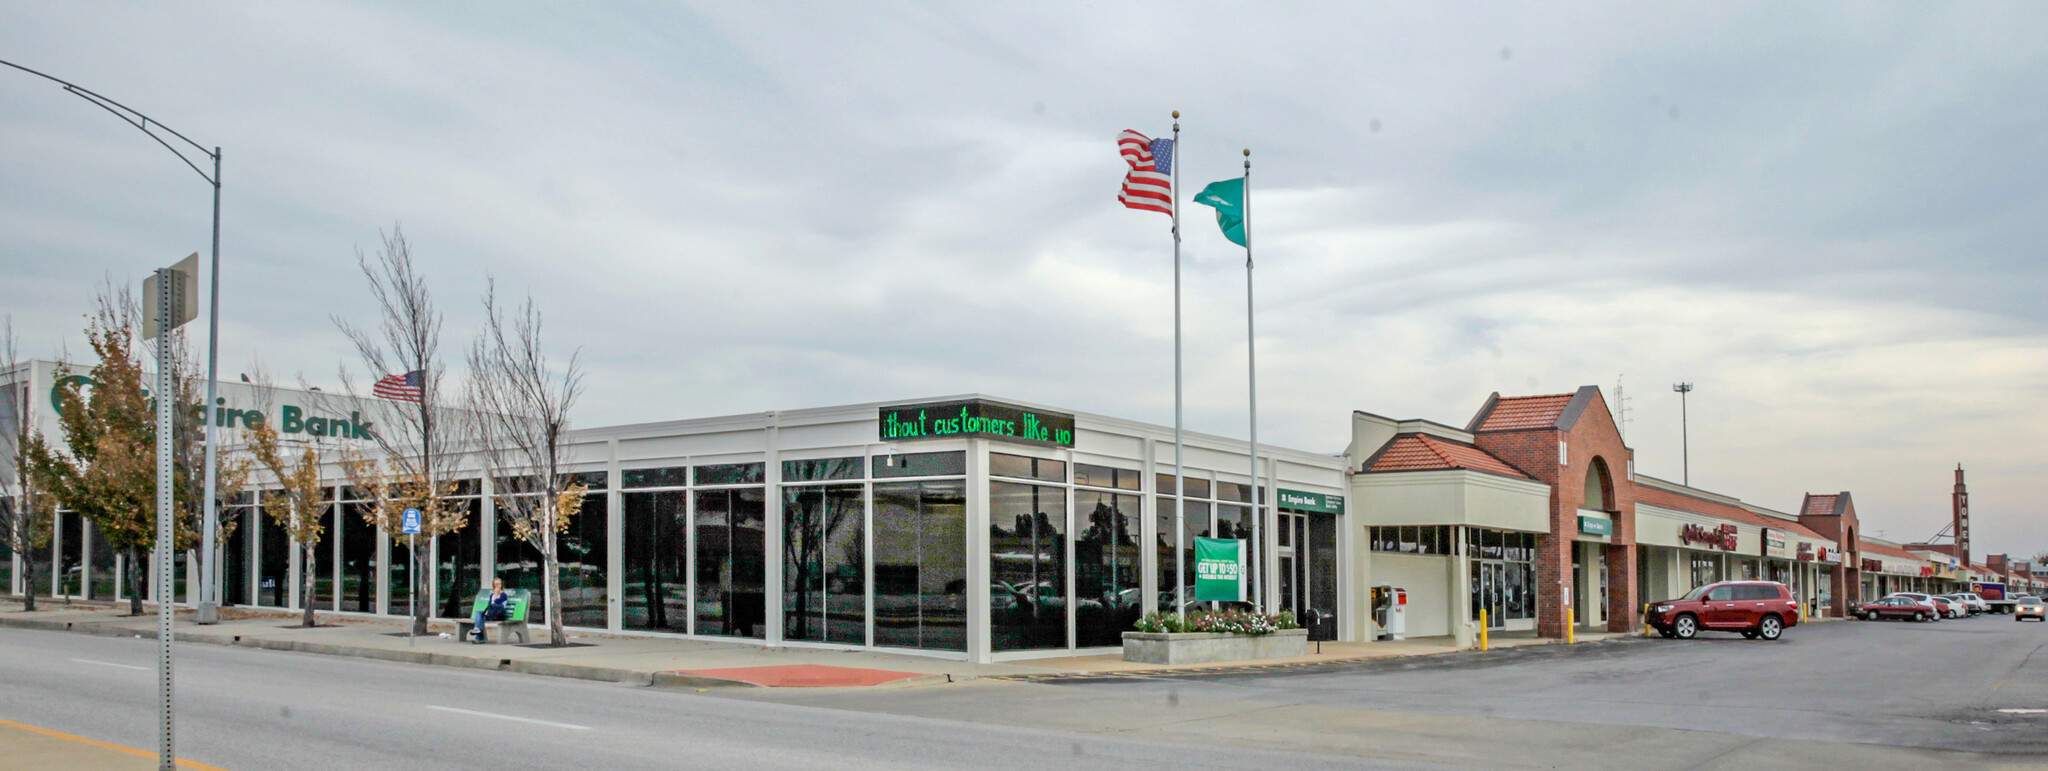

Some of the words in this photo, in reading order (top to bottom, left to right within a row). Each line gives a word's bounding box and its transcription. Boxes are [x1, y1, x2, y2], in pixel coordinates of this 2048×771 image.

[282, 404, 374, 440] Bank
[934, 406, 1015, 436] customers
[1023, 413, 1049, 441] like
[1303, 496, 1316, 505] Bank
[1198, 562, 1210, 574] GET
[1210, 562, 1218, 574] UP
[1218, 562, 1226, 574] TO
[1226, 563, 1238, 575] $50
